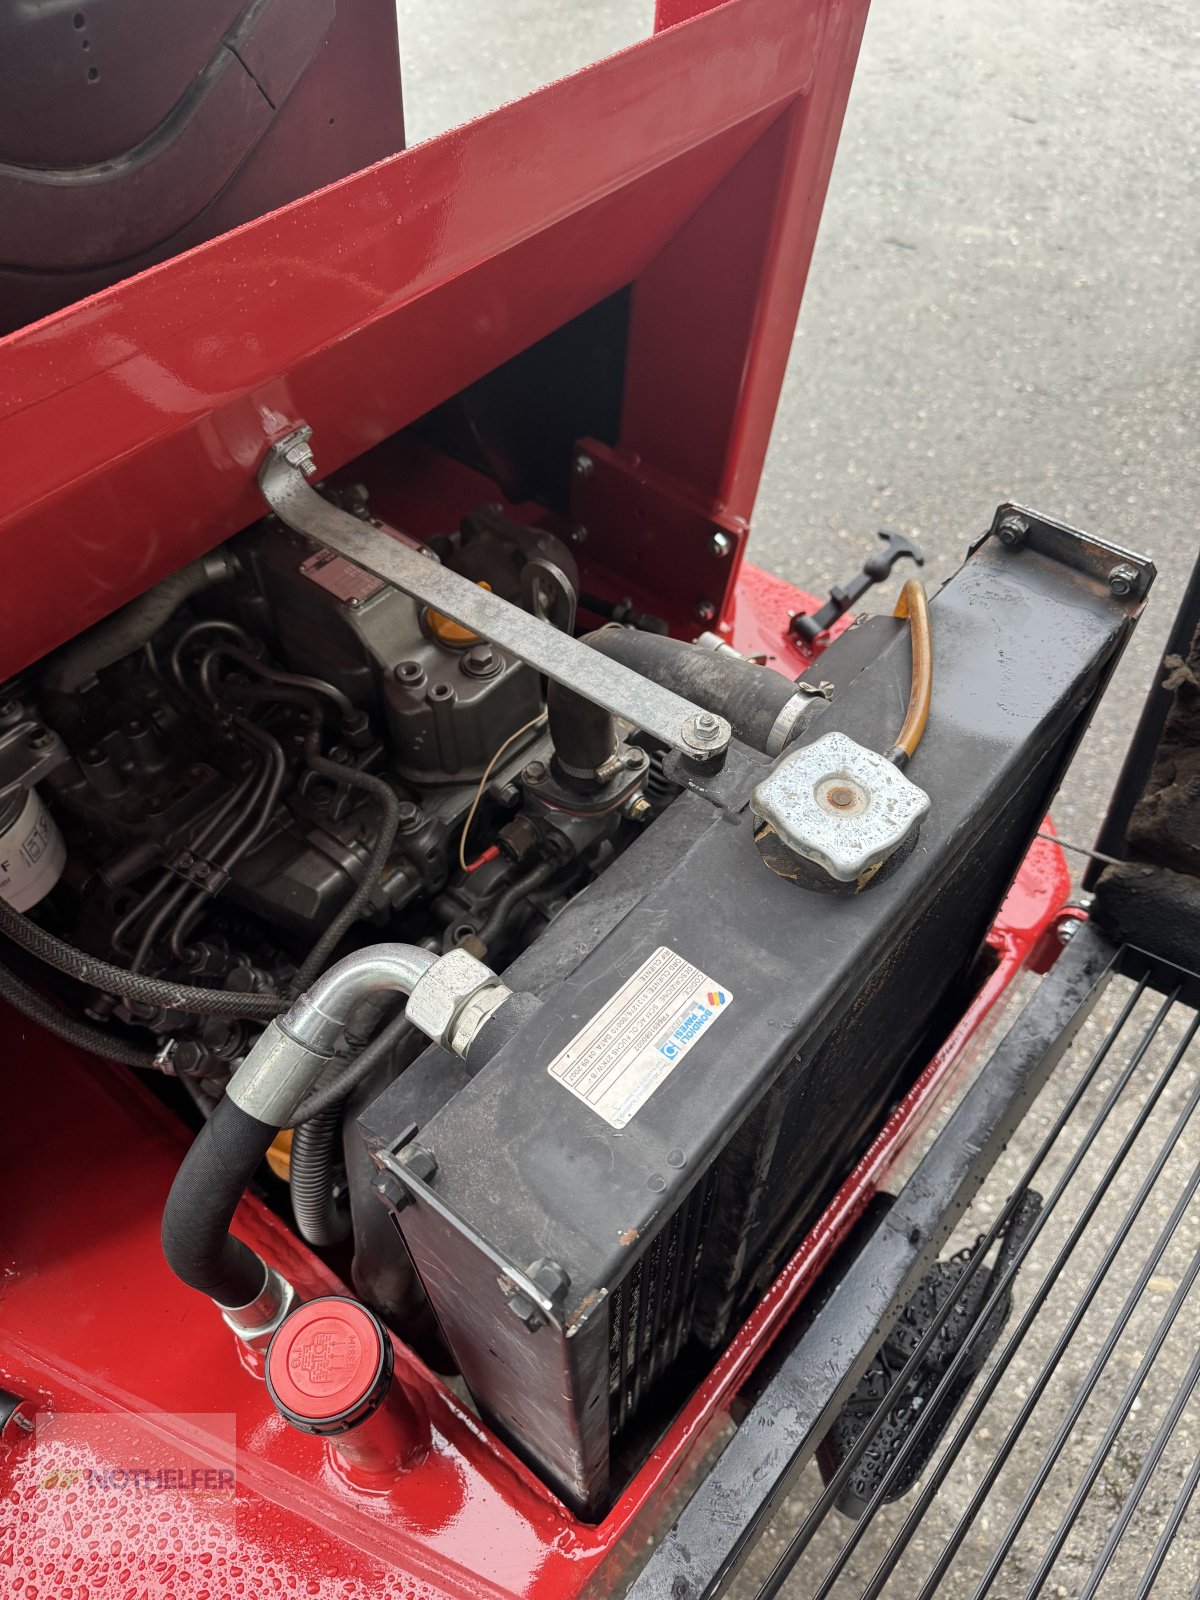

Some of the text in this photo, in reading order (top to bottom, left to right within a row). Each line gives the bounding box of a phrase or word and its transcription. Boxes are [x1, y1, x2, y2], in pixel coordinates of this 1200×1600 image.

[643, 1003, 659, 1018] SCM
[672, 1003, 706, 1039] & PAVESI
[679, 1009, 713, 1045] BONDIOLI
[610, 1034, 631, 1056] FUCHS
